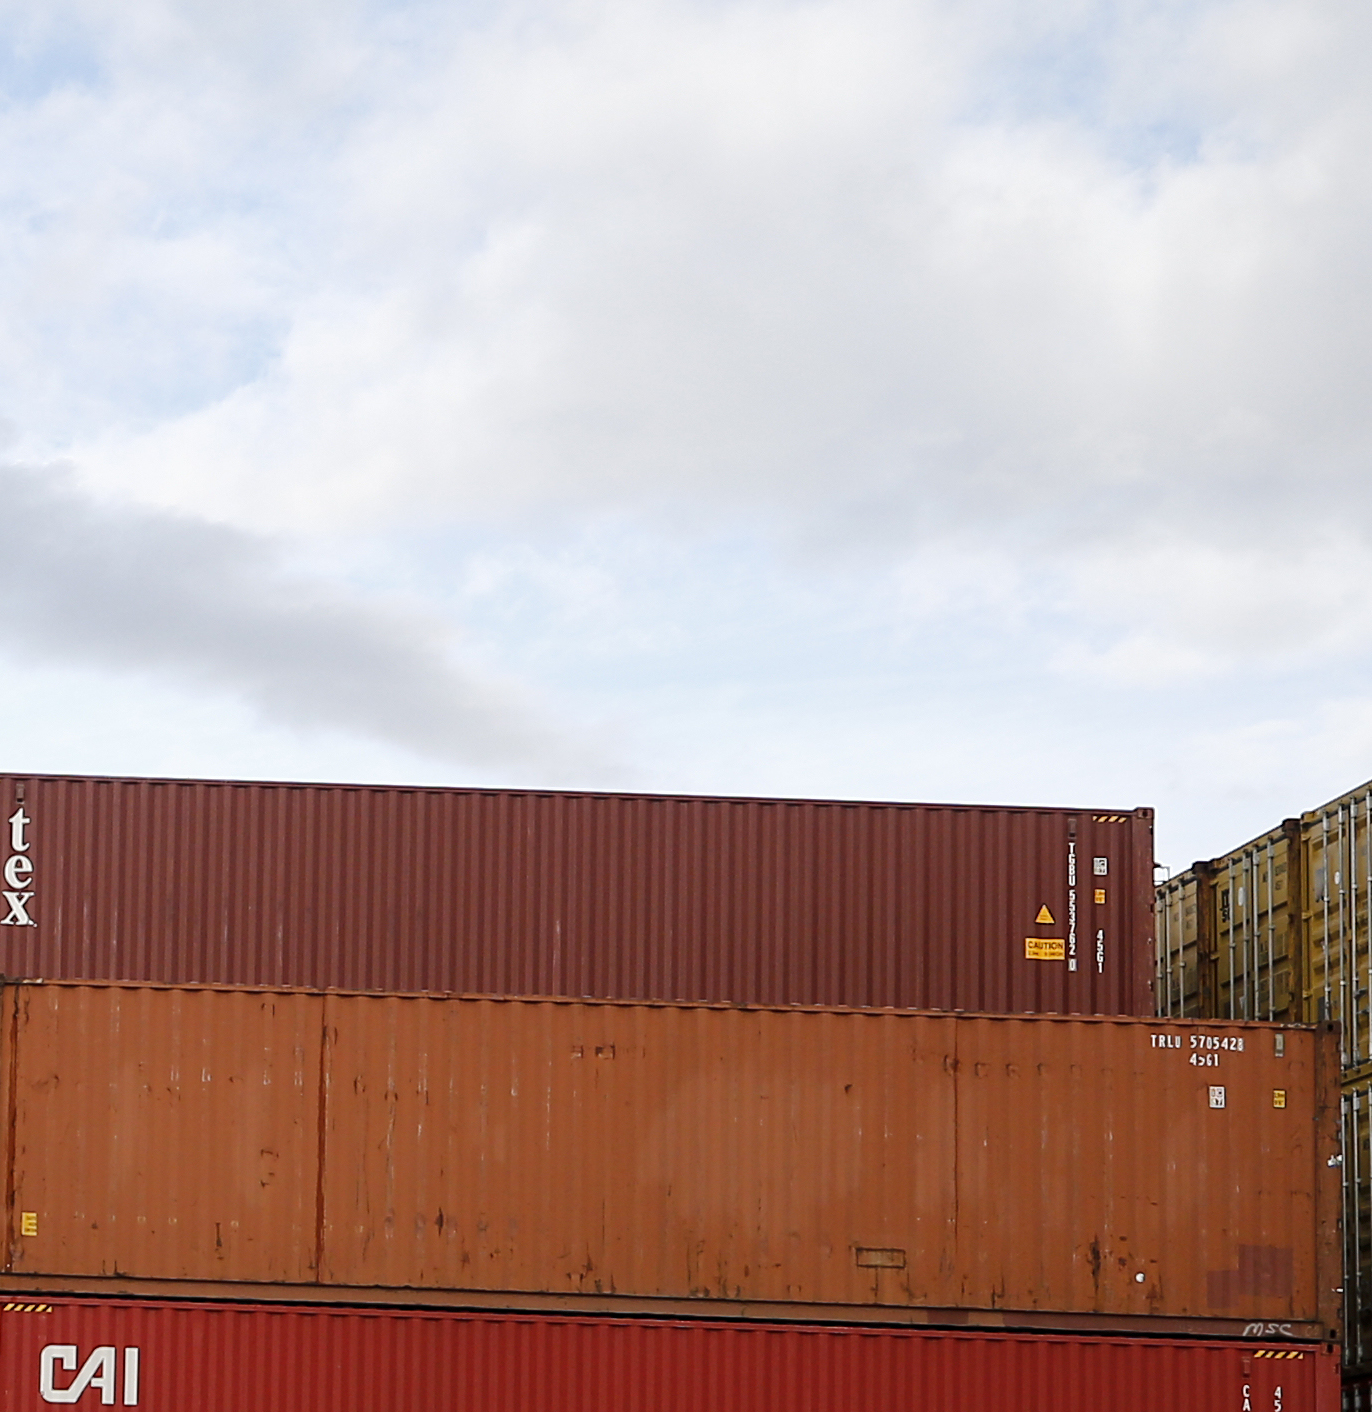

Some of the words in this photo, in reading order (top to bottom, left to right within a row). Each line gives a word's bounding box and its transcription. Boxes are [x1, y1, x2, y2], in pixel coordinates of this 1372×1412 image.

[1068, 842, 1076, 886] TGBU
[1028, 941, 1063, 949] CAUTION
[1096, 930, 1104, 973] 45G1
[1151, 1034, 1182, 1048] TRLU
[40, 1344, 139, 1406] CAI
